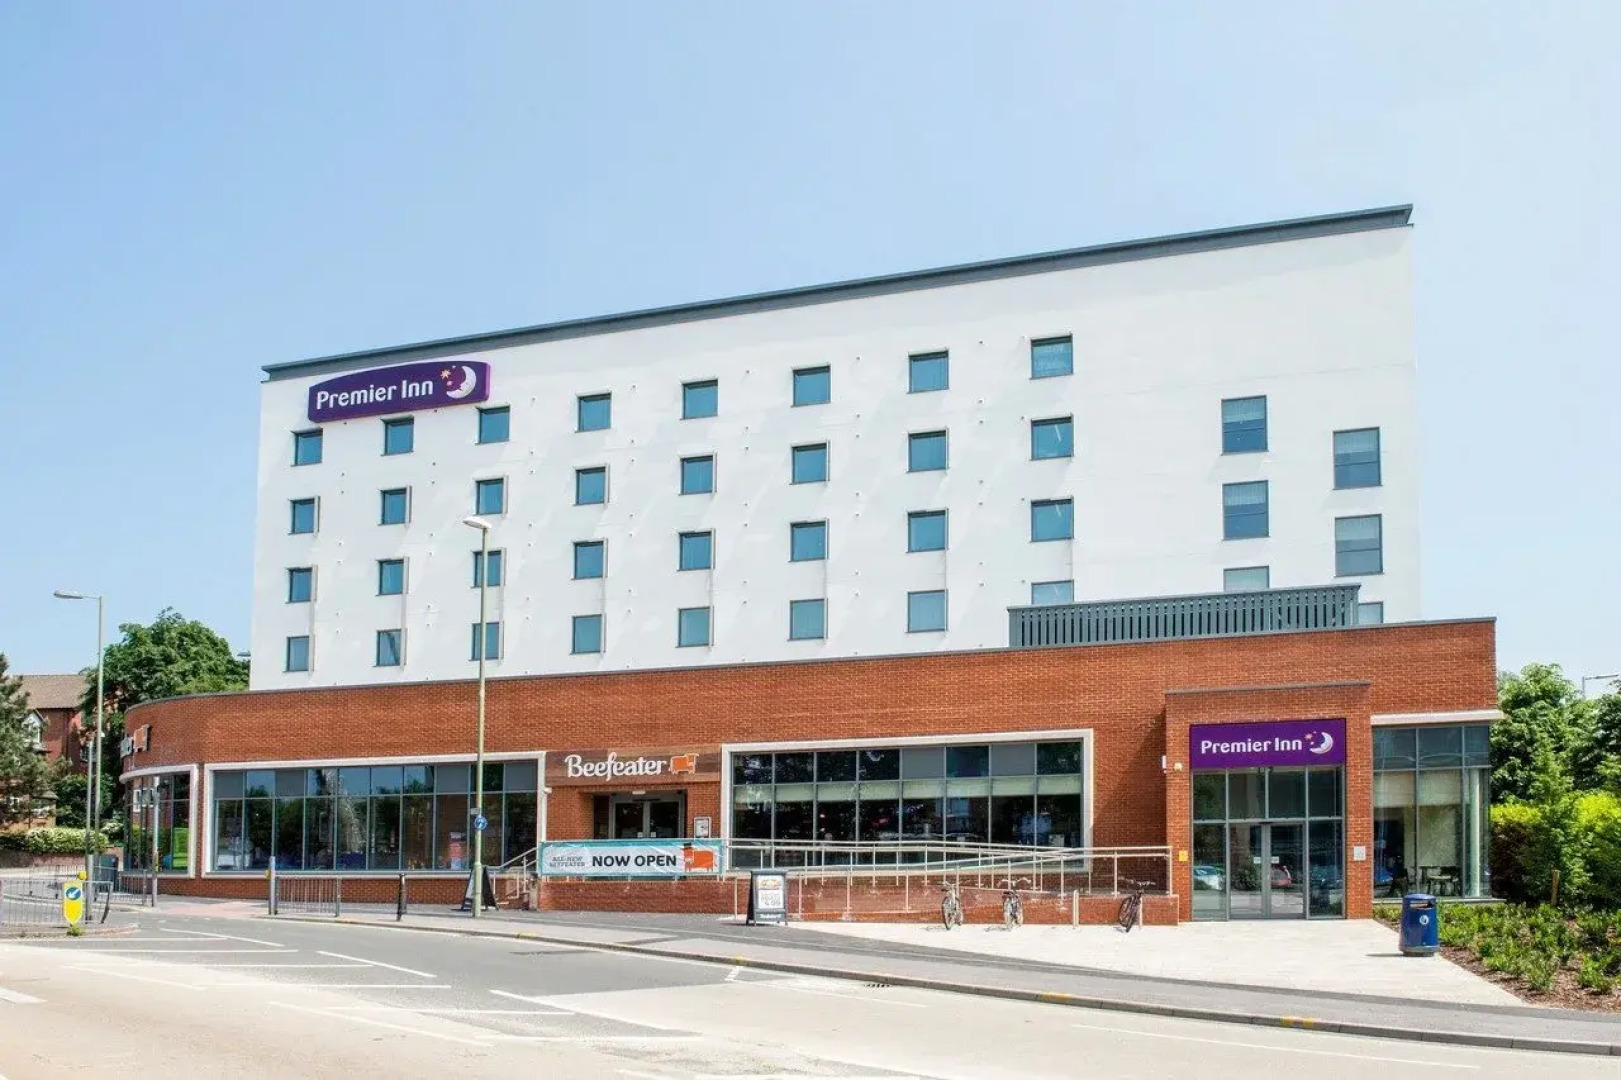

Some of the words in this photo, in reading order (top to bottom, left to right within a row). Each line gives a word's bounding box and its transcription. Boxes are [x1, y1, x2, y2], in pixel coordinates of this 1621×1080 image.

[316, 384, 397, 410] Premier
[401, 379, 434, 398] Inn
[1201, 738, 1272, 754] Premier
[1274, 737, 1302, 751] Inn
[564, 751, 667, 781] Beefeater
[592, 855, 631, 867] NOW
[634, 855, 677, 867] OPEN
